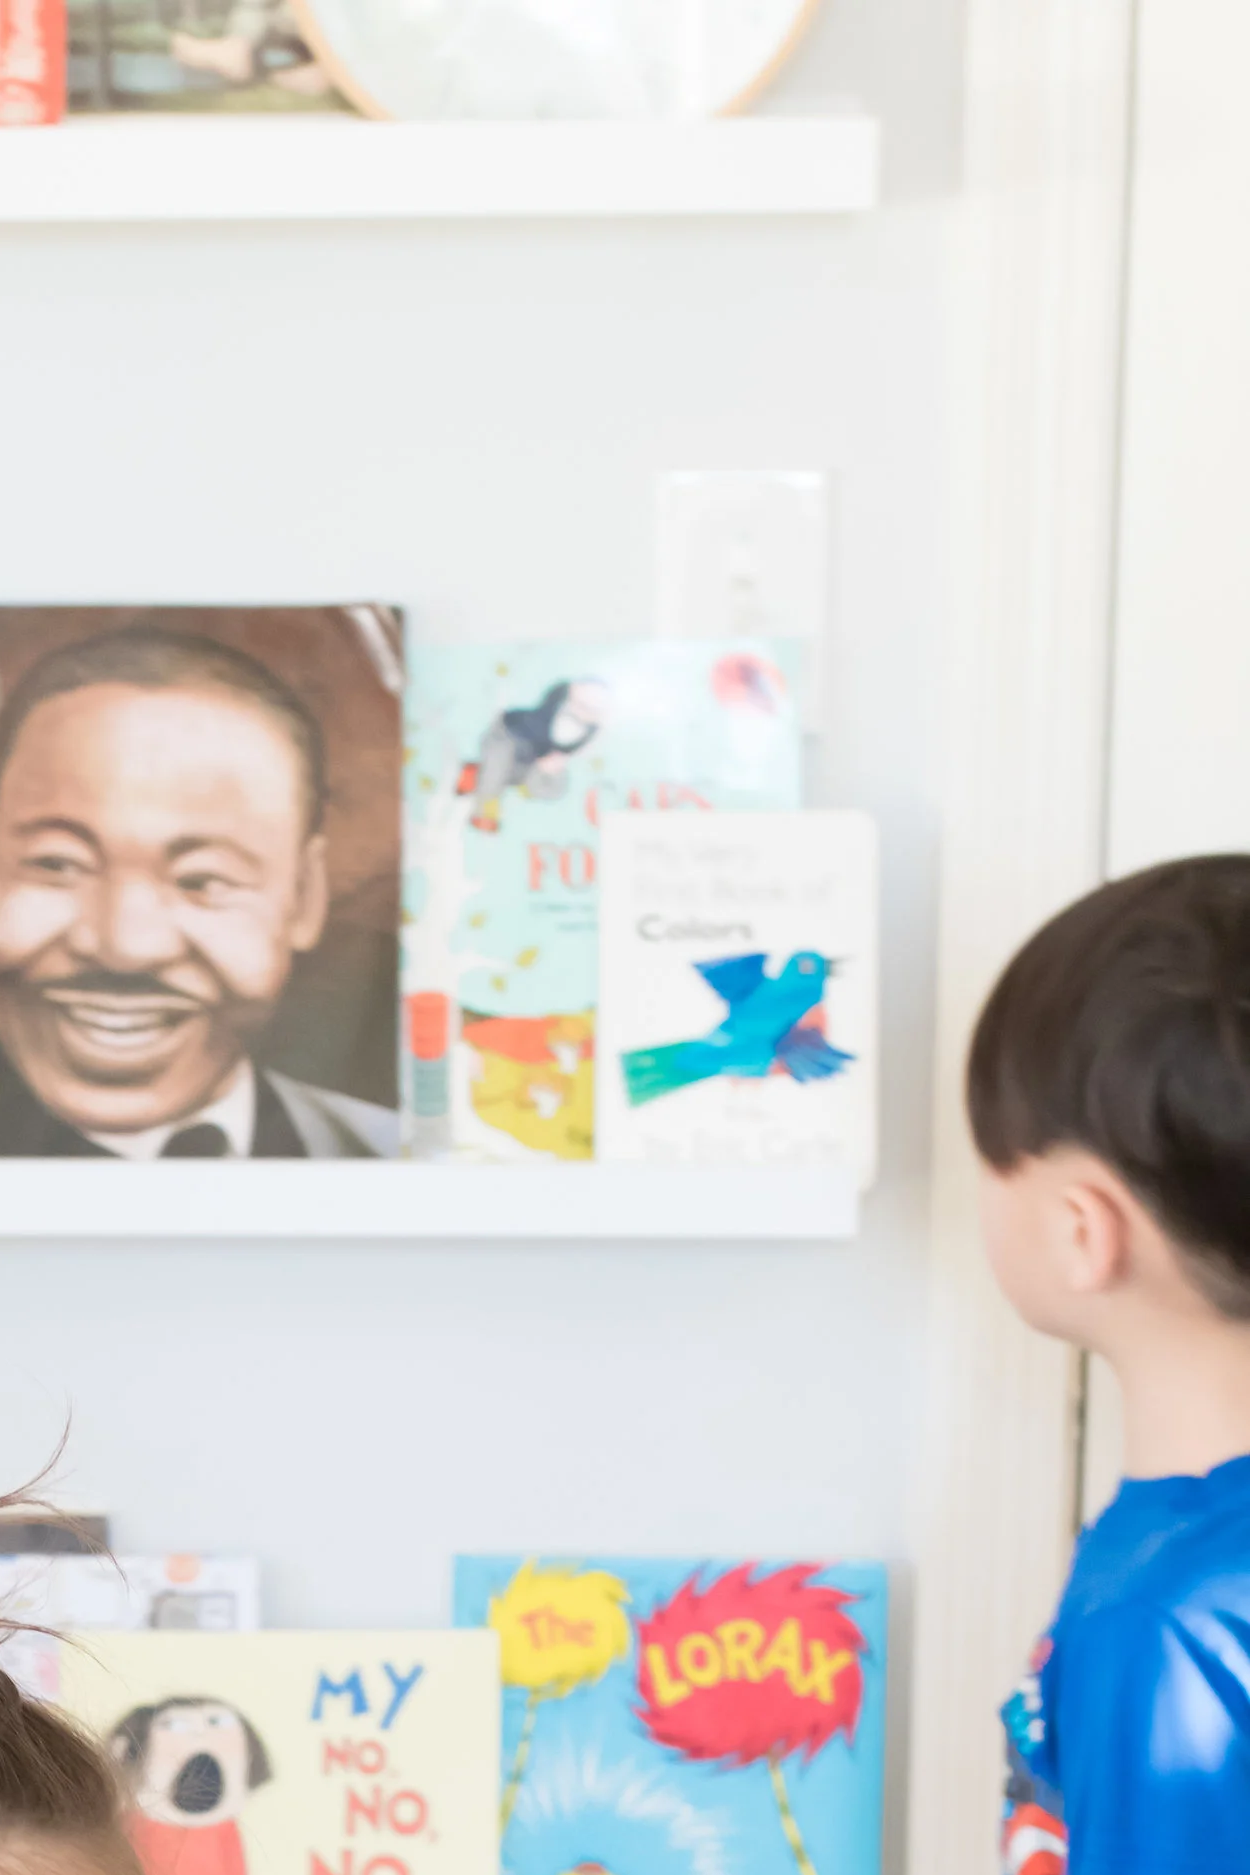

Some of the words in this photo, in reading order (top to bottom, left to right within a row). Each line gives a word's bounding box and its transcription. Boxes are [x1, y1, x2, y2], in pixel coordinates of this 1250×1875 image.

[635, 912, 756, 944] Colors
[519, 1604, 595, 1651] The
[647, 1617, 853, 1707] LORAX
[309, 1662, 425, 1731] MY
